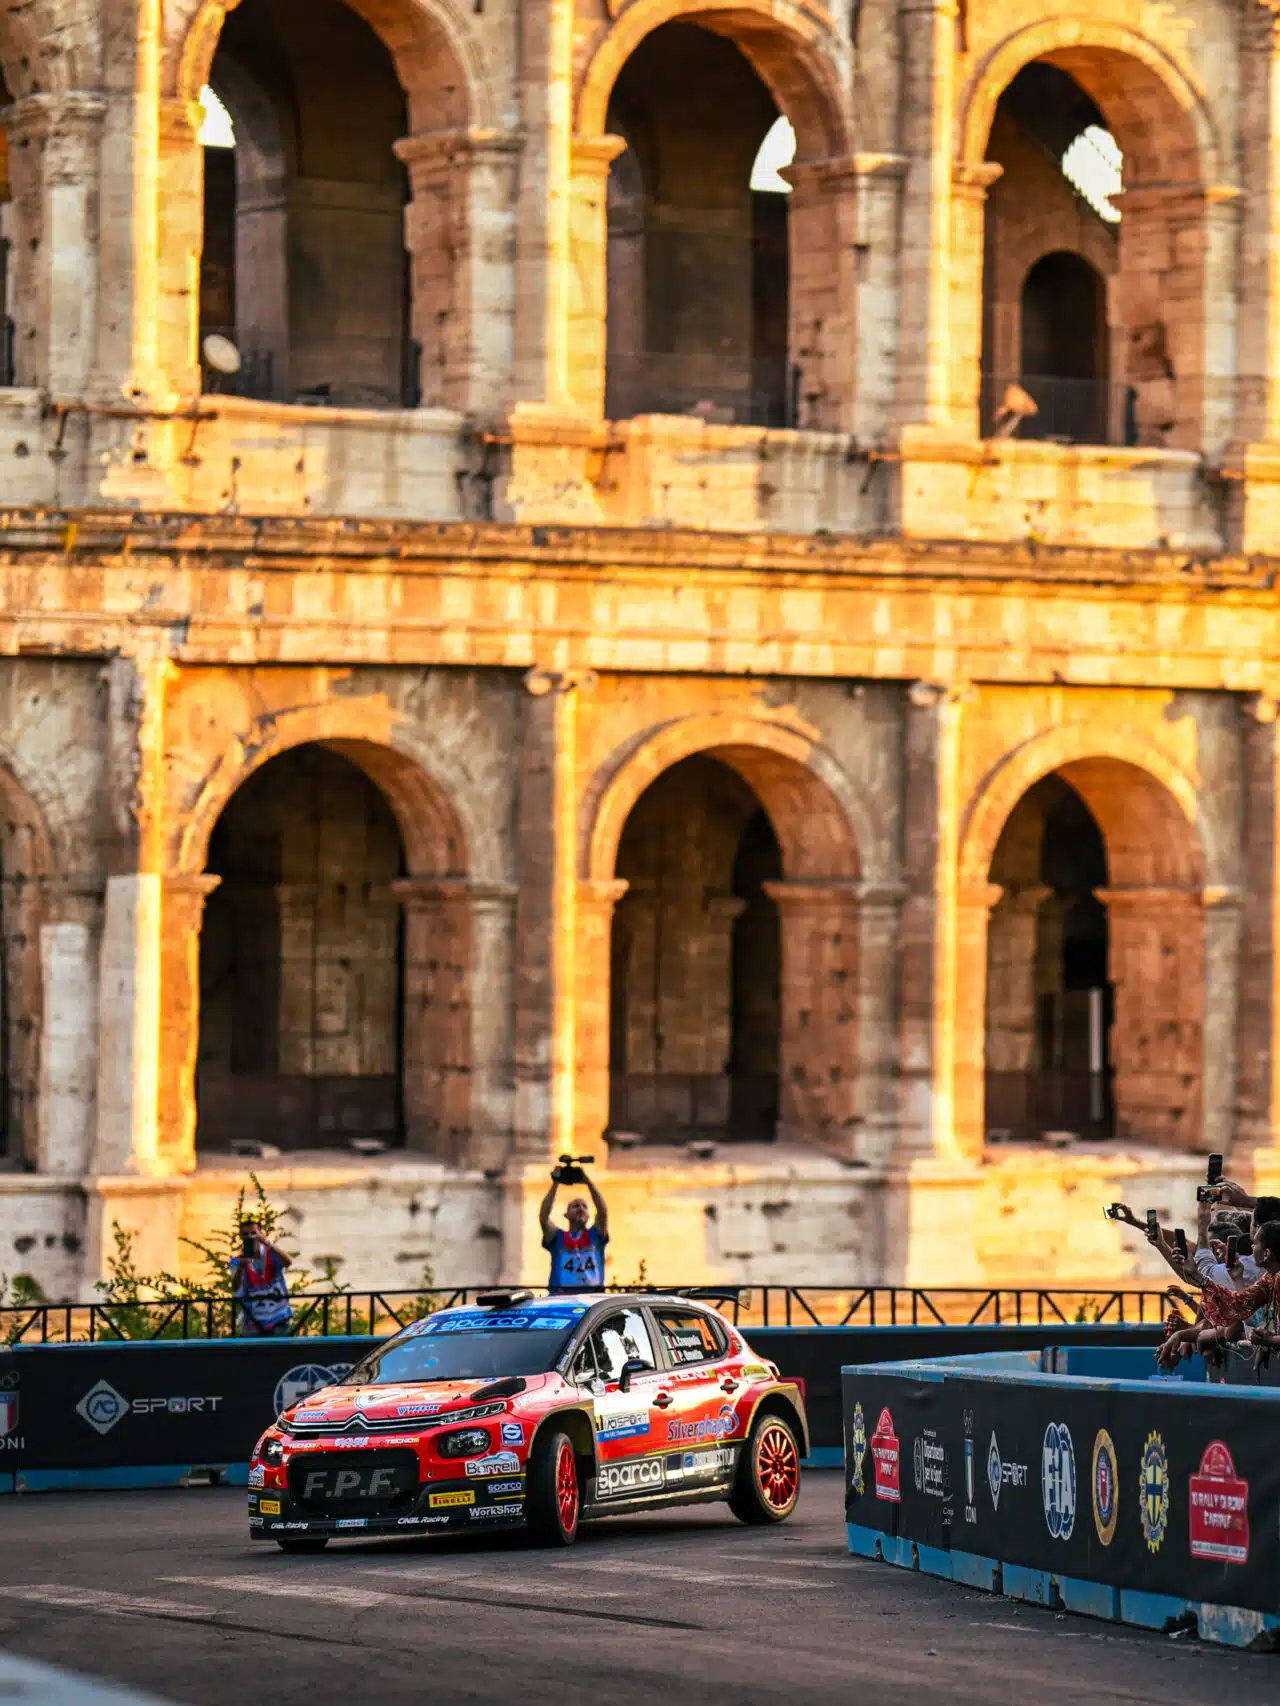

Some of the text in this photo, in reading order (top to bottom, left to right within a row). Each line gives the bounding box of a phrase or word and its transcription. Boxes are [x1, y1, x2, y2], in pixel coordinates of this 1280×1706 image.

[132, 1395, 223, 1414] SPORT
[0, 1437, 25, 1450] ONI
[302, 1468, 401, 1499] F.P.F.
[598, 1461, 661, 1495] sparco
